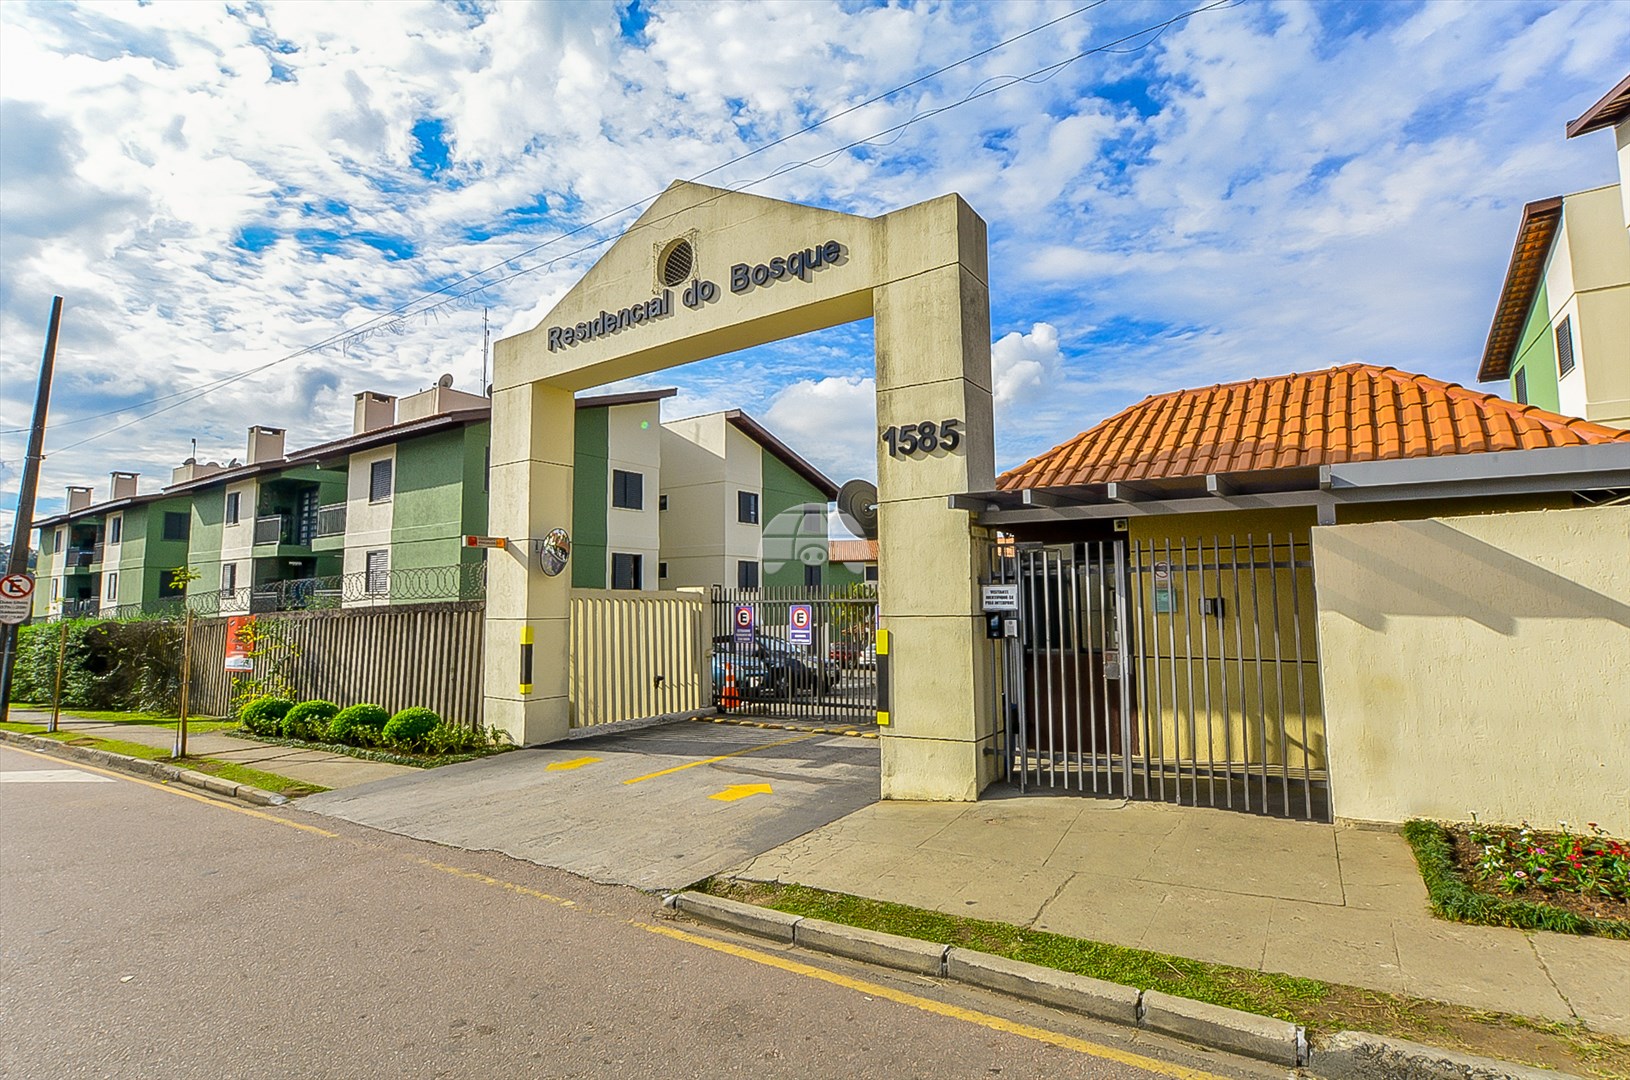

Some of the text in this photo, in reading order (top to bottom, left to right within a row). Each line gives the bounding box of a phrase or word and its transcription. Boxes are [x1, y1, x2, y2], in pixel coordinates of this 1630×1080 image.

[547, 239, 848, 352] Residencial do Bosque
[882, 418, 960, 458] 1585
[740, 612, 748, 623] E
[796, 612, 804, 623] E
